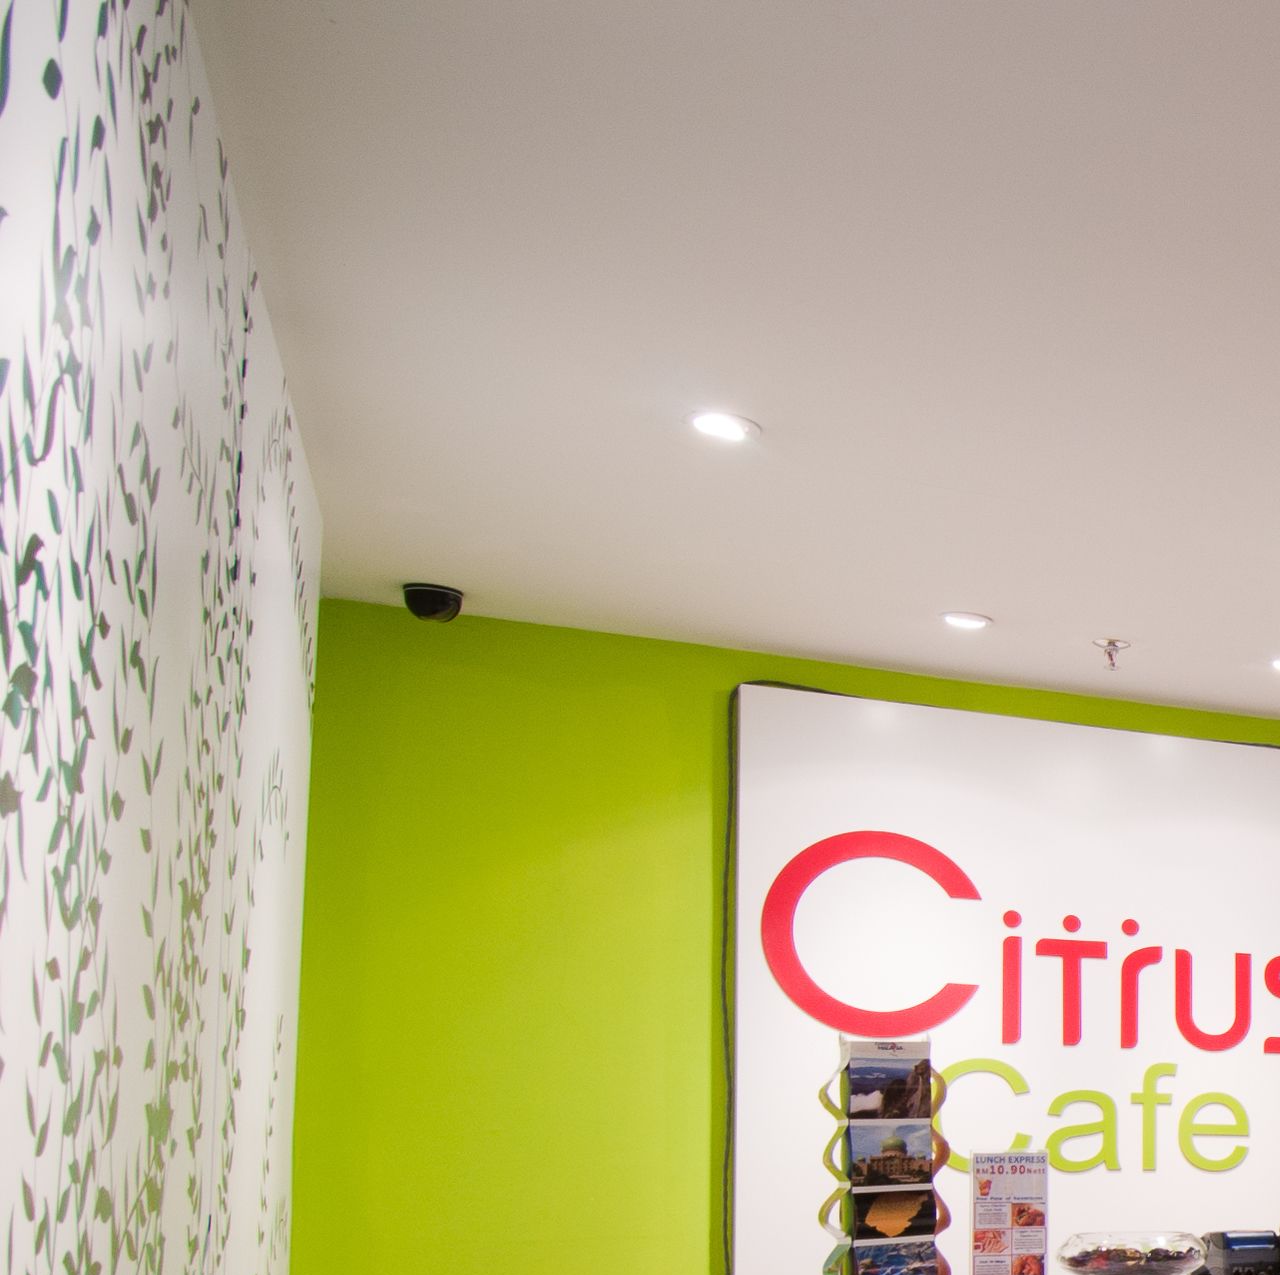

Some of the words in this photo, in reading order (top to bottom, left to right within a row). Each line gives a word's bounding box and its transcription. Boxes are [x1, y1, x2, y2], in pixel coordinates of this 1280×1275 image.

[932, 1058, 1251, 1172] Cafe
[975, 1156, 1006, 1164] LUNCH
[1008, 1156, 1046, 1164] EXPRESS
